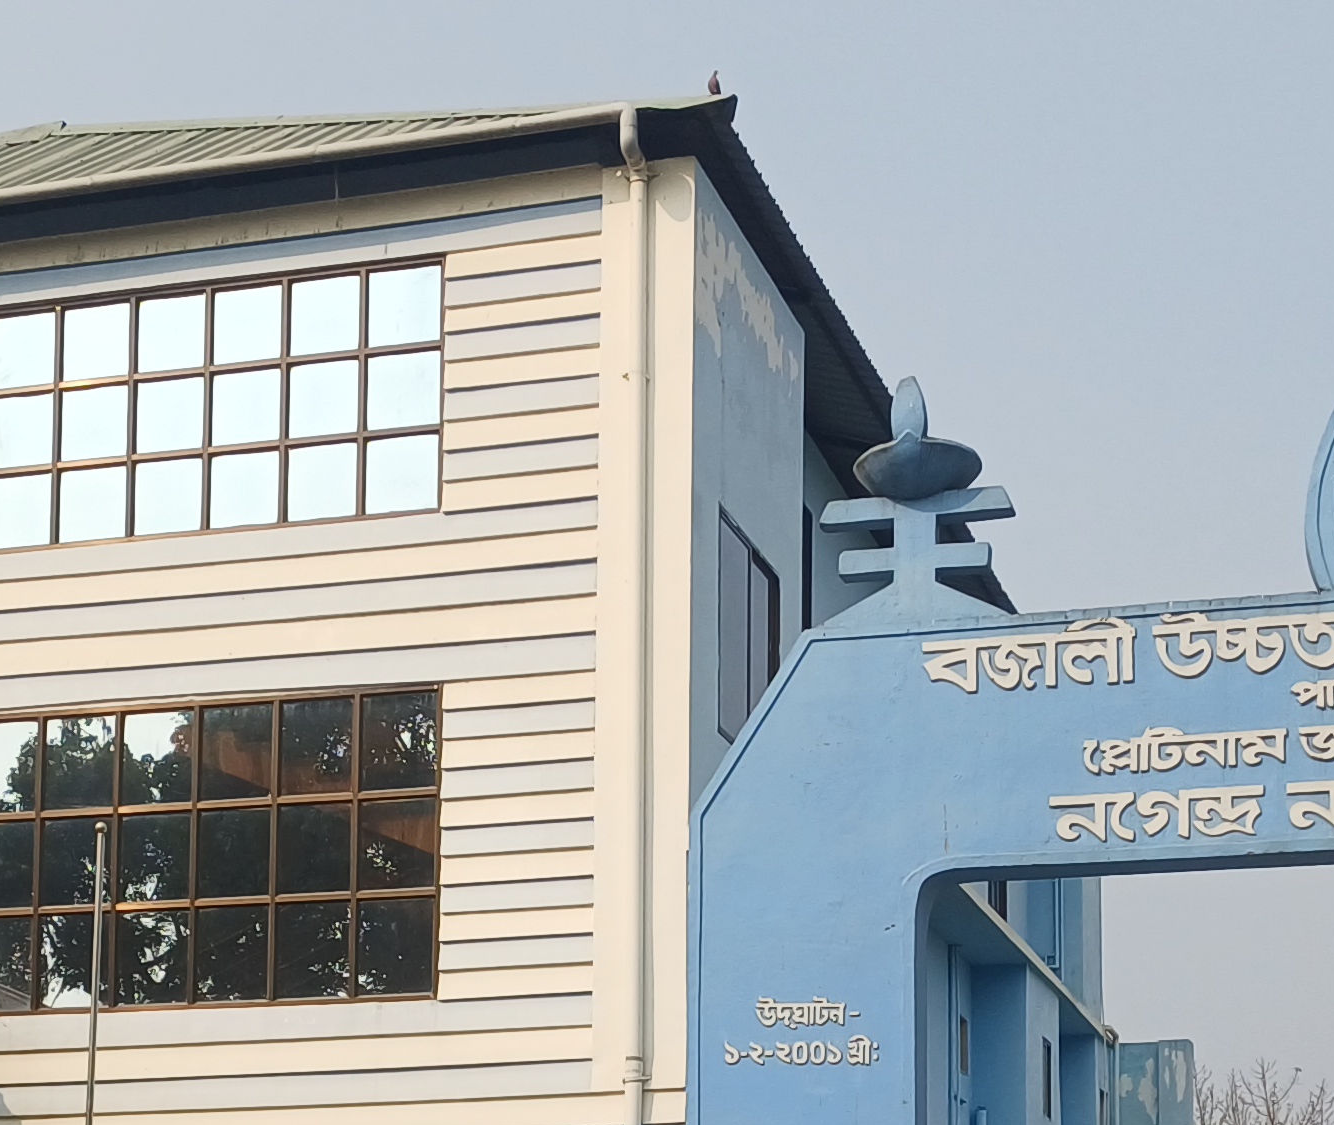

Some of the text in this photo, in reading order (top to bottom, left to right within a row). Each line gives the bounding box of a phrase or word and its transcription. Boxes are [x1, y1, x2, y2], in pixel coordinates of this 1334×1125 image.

[923, 615, 1136, 692] বজালী
[1084, 727, 1286, 774] প্লেটিনাম
[1049, 785, 1264, 841] নগেন্দ্ৰ
